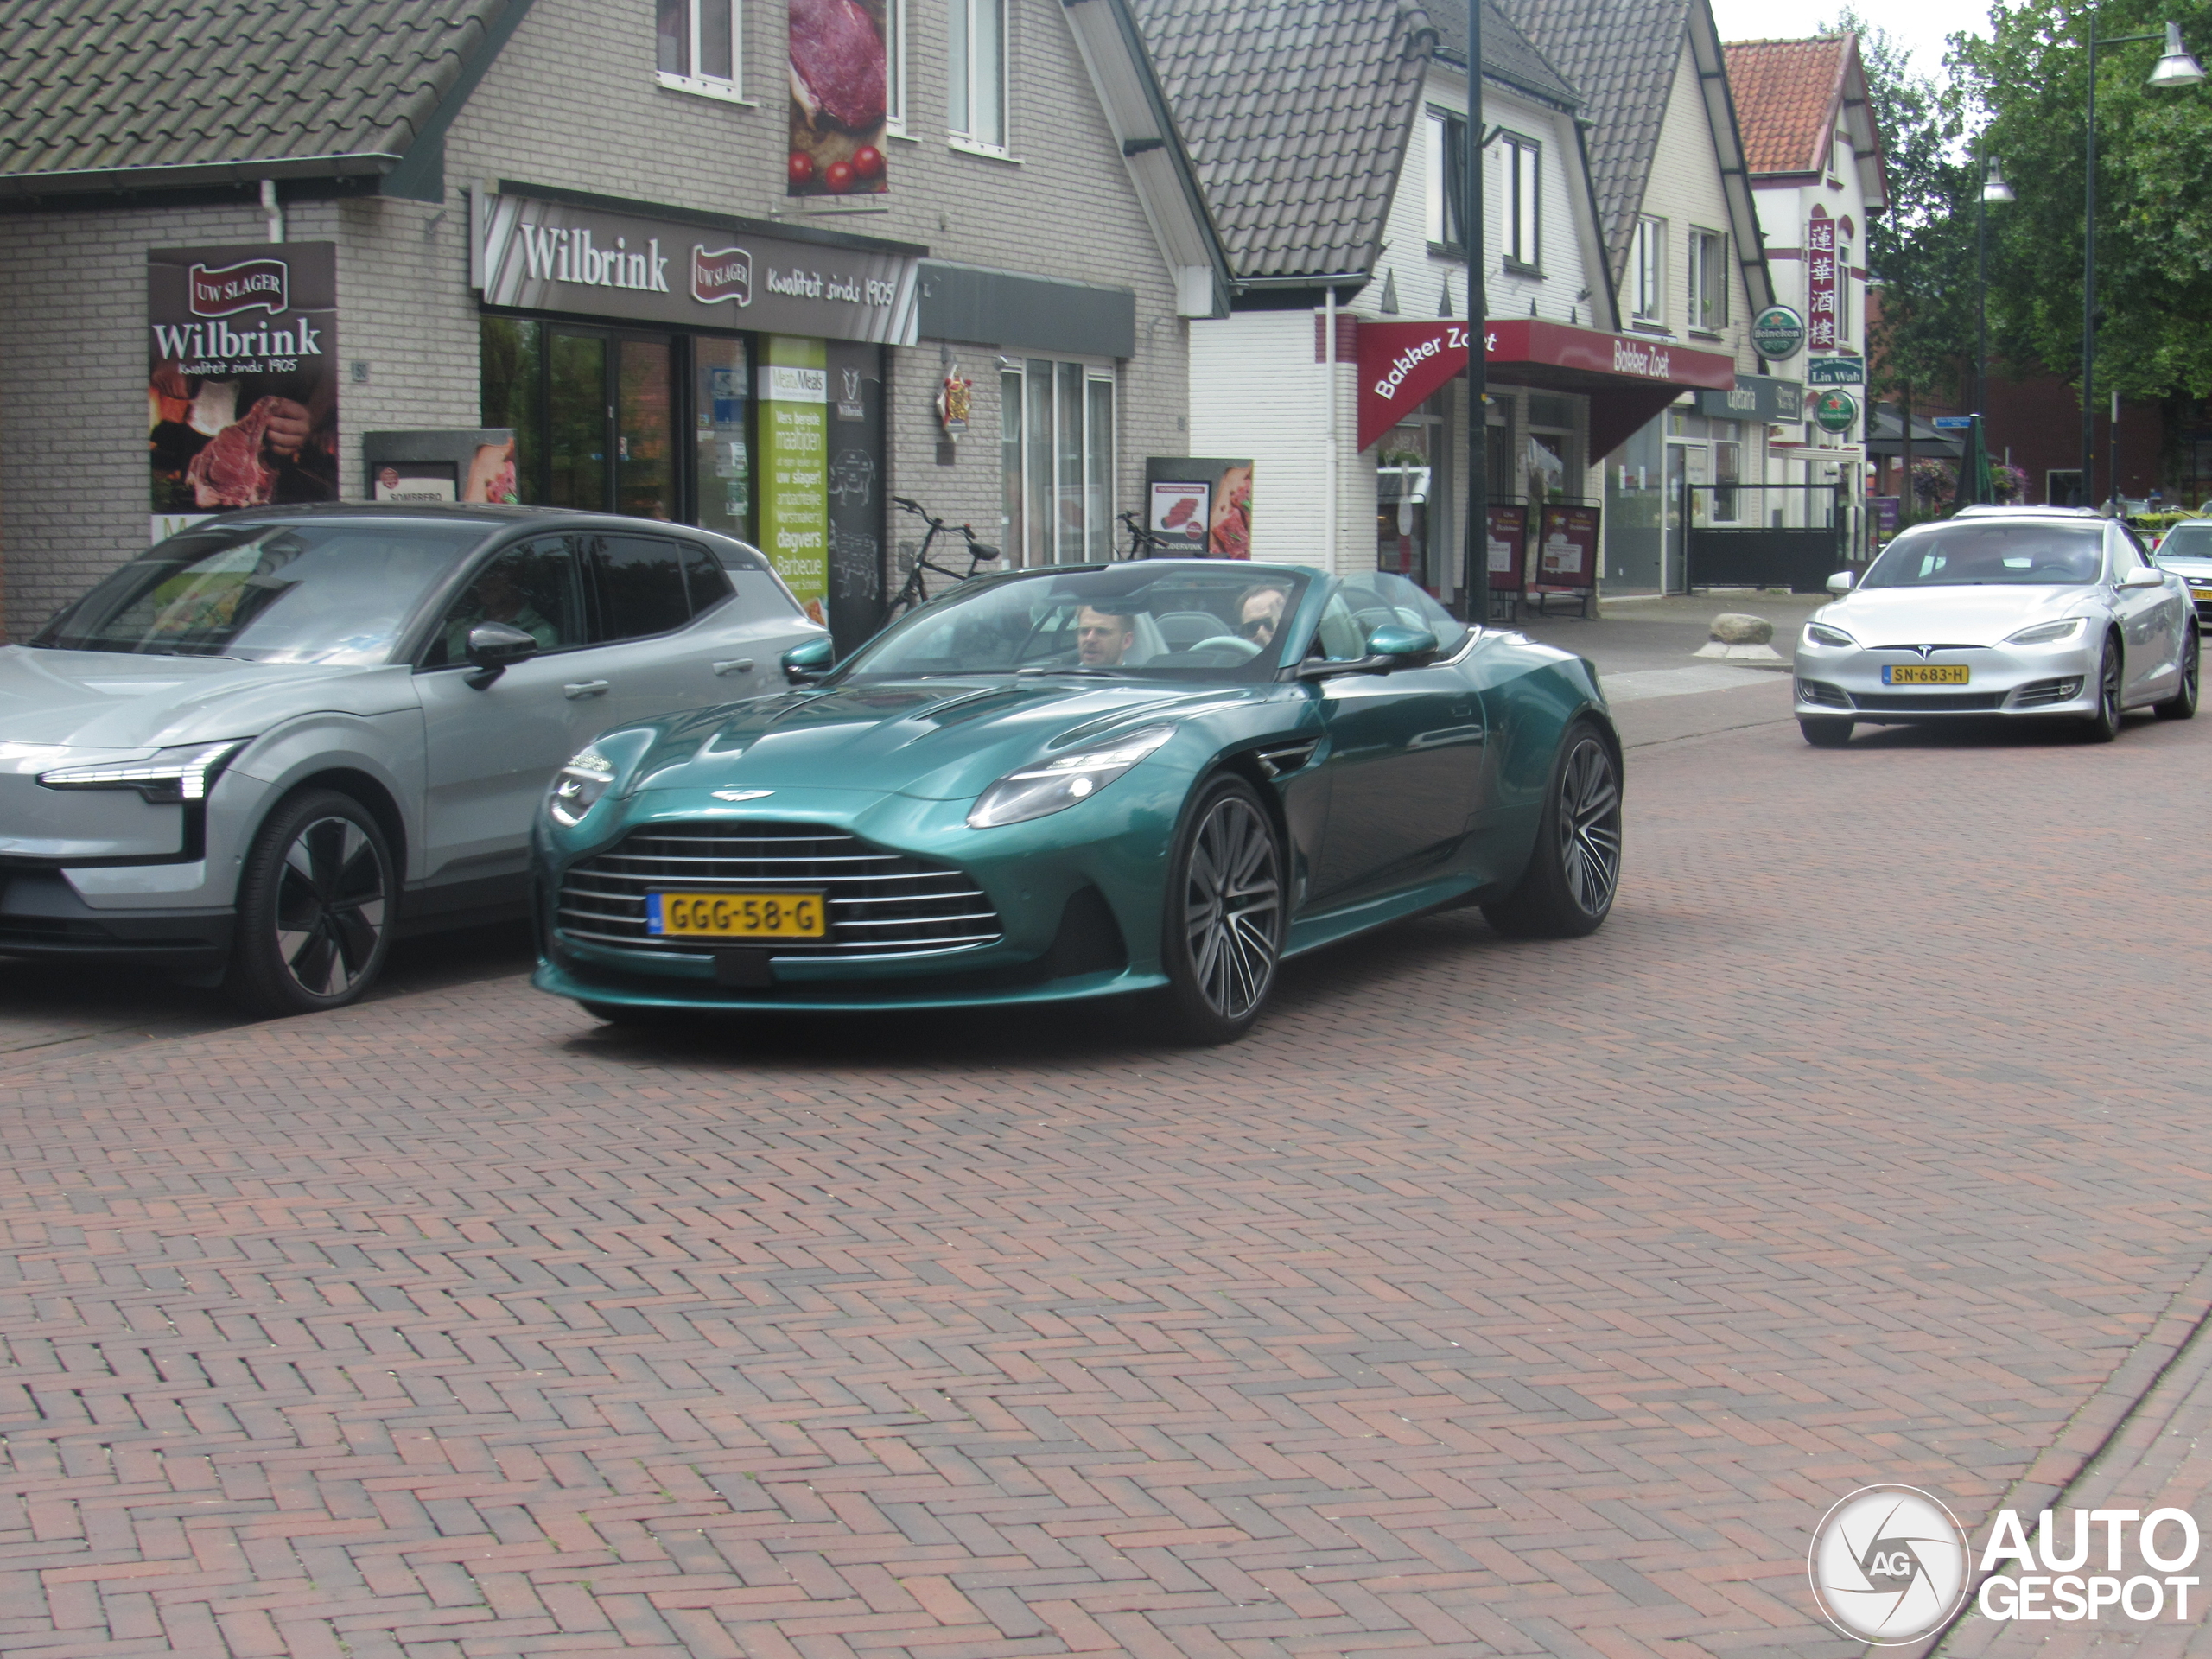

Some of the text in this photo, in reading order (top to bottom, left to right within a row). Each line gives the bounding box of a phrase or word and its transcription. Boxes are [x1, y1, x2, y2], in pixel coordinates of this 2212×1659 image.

[520, 223, 670, 293] Wilbrink
[196, 273, 282, 302] UW SLAGER
[697, 264, 748, 287] UW SLAGER
[766, 267, 895, 306] Kwaliteit sinds 1905
[1810, 225, 1834, 346] 蓮華酒樓
[152, 317, 322, 359] Wilbrink
[1754, 328, 1800, 339] Heineken
[178, 359, 298, 375] Kwaliteit sinds 1905
[1374, 327, 1497, 400] Bakker Zot
[1614, 340, 1669, 378] Bakker Zoet
[1812, 371, 1860, 382] Lin Wah
[776, 472, 790, 484] uw
[777, 526, 822, 553] dagvers
[777, 555, 822, 575] Barbecue
[1895, 669, 1962, 681] SN-683-H
[671, 899, 814, 930] GGG-58-G
